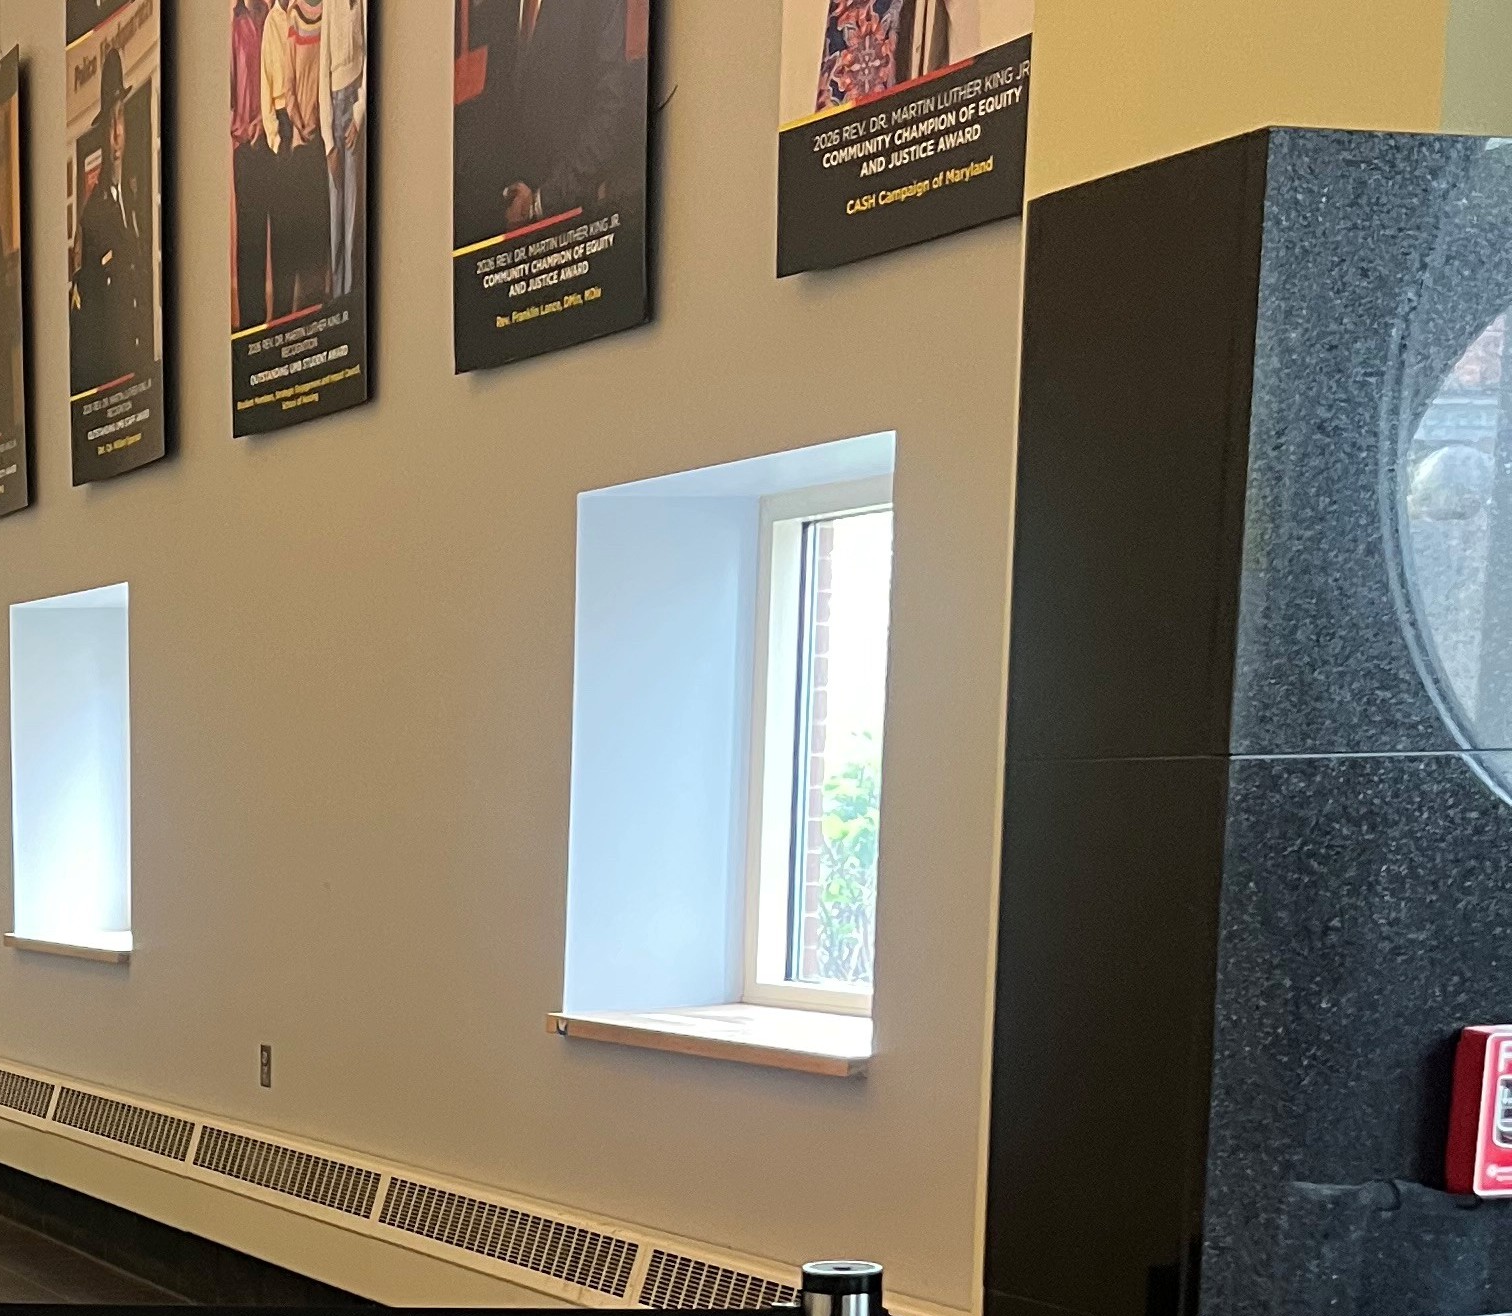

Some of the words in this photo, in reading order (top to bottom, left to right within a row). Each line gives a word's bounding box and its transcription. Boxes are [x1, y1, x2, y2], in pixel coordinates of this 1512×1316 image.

[814, 131, 840, 151] 2026
[843, 124, 866, 142] REV.
[870, 117, 887, 132] DR.
[891, 98, 935, 126] MARTIN
[938, 82, 982, 110] LUTHER
[984, 67, 1013, 92] KING
[823, 133, 892, 168] COMMUNITY
[894, 115, 956, 145] CHAMPION
[959, 107, 975, 123] OF
[978, 86, 1023, 116] EQUITY
[860, 157, 886, 177] AND
[888, 140, 934, 169] JUSTICE
[937, 124, 981, 153] AWARD
[846, 193, 876, 215] CASH
[878, 178, 930, 206] Campaign
[932, 172, 943, 189] of
[945, 155, 994, 185] Maryland
[483, 263, 530, 288] COMMUNITY
[531, 250, 572, 273] CHAMPION
[573, 243, 585, 259] OF
[586, 233, 615, 255] EQUITY
[529, 237, 558, 257] MARTIN
[559, 225, 588, 247] LUTHER
[589, 218, 608, 236] KING
[509, 281, 527, 298] AND
[528, 270, 559, 291] JUSTICE
[560, 261, 589, 281] AWARD
